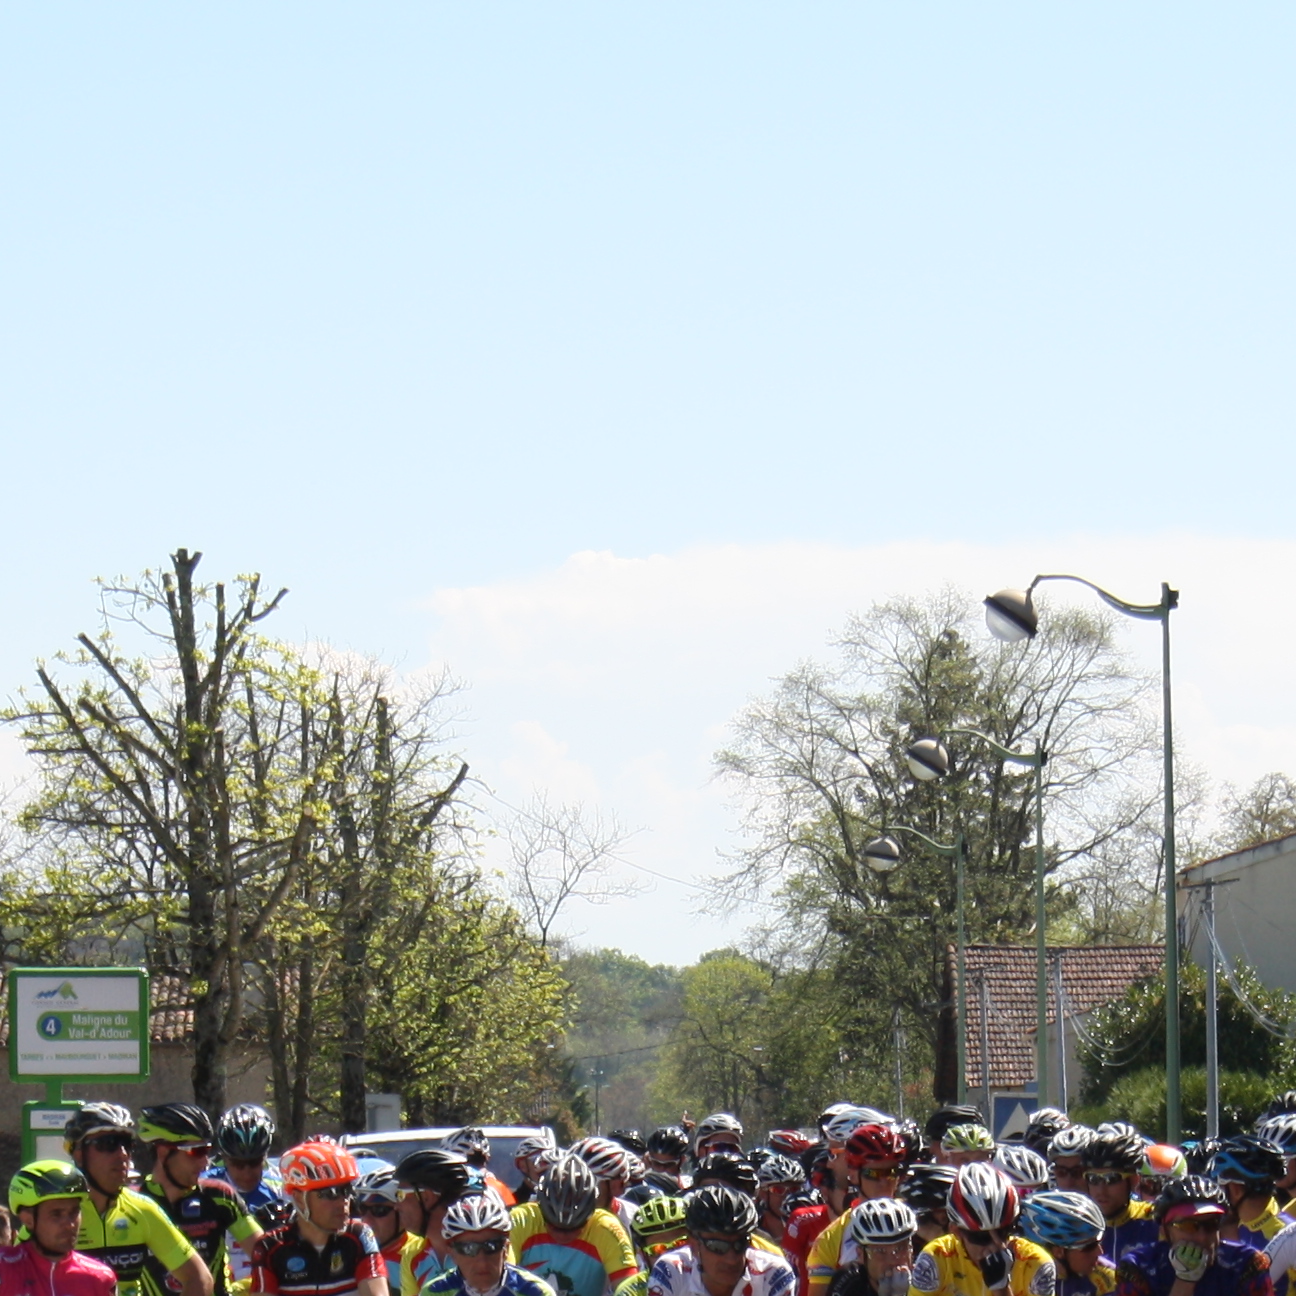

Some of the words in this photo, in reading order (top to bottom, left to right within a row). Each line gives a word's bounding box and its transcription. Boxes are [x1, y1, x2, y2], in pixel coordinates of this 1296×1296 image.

[45, 1019, 56, 1035] 4
[72, 1014, 112, 1029] Maligne
[114, 1014, 128, 1026] du
